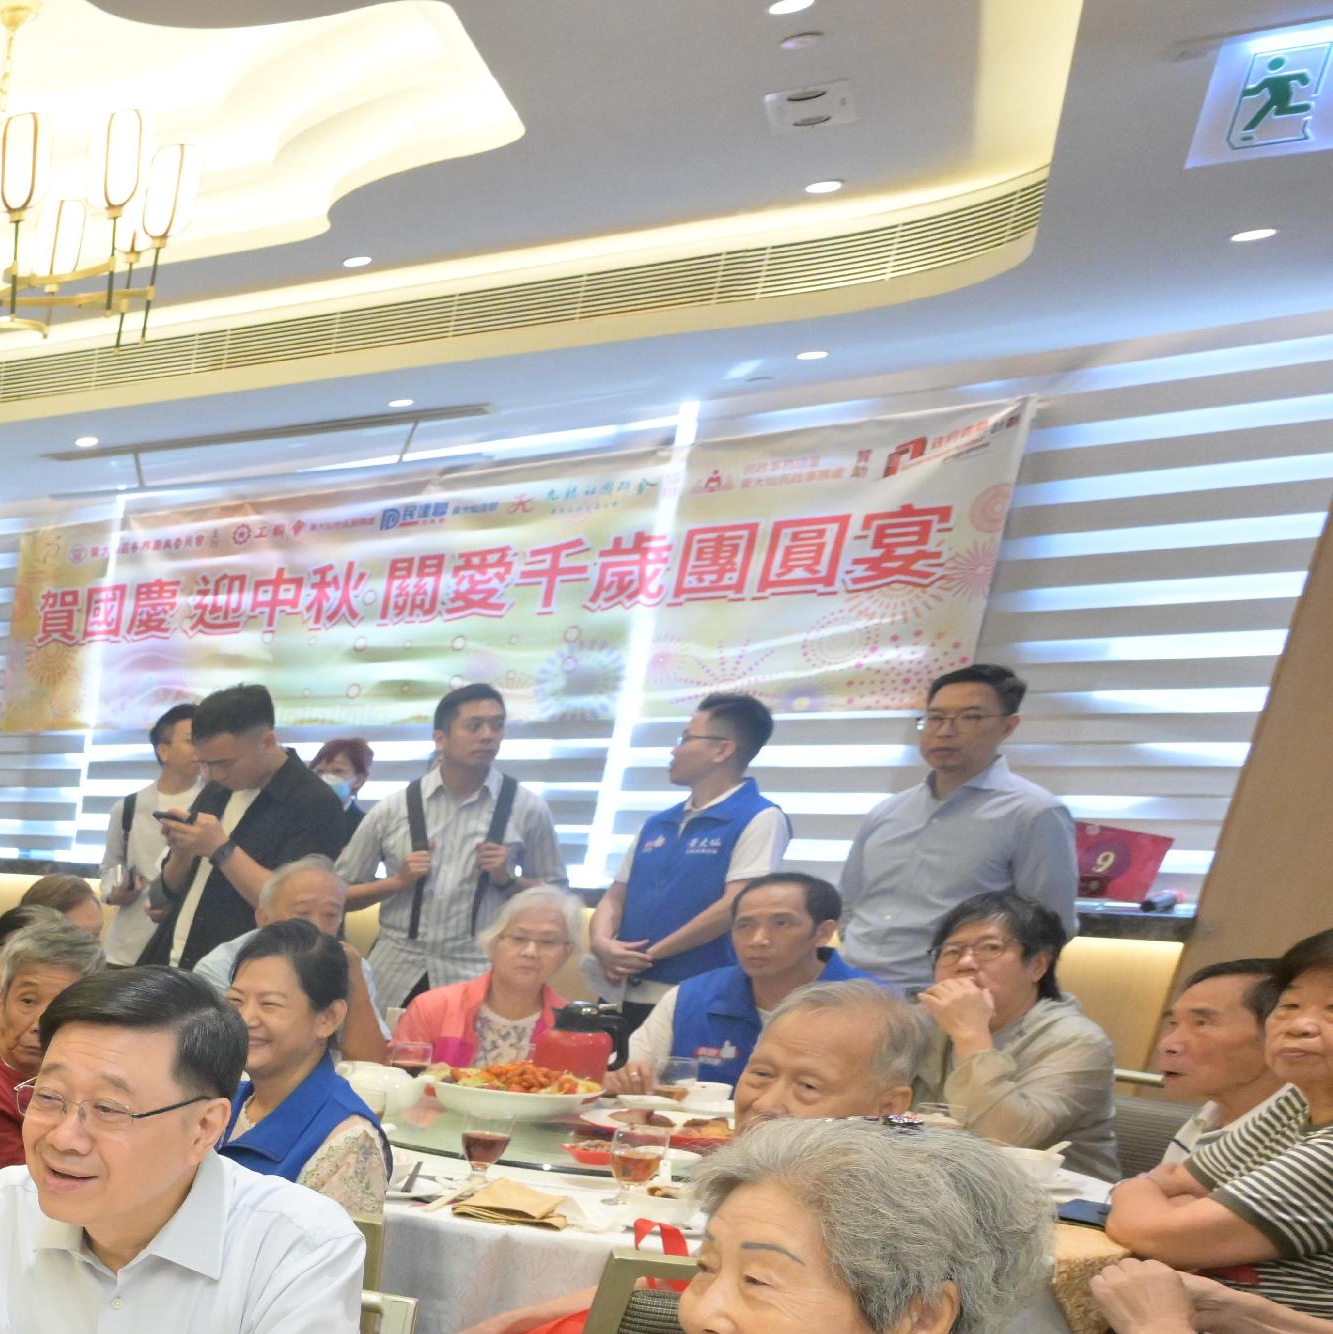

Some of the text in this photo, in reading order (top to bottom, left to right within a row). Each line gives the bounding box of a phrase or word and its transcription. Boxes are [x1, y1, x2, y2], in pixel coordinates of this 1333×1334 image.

[34, 503, 954, 643] 賀國慶 迎中秋 關愛千歲團圓宴
[1092, 851, 1116, 873] 9
